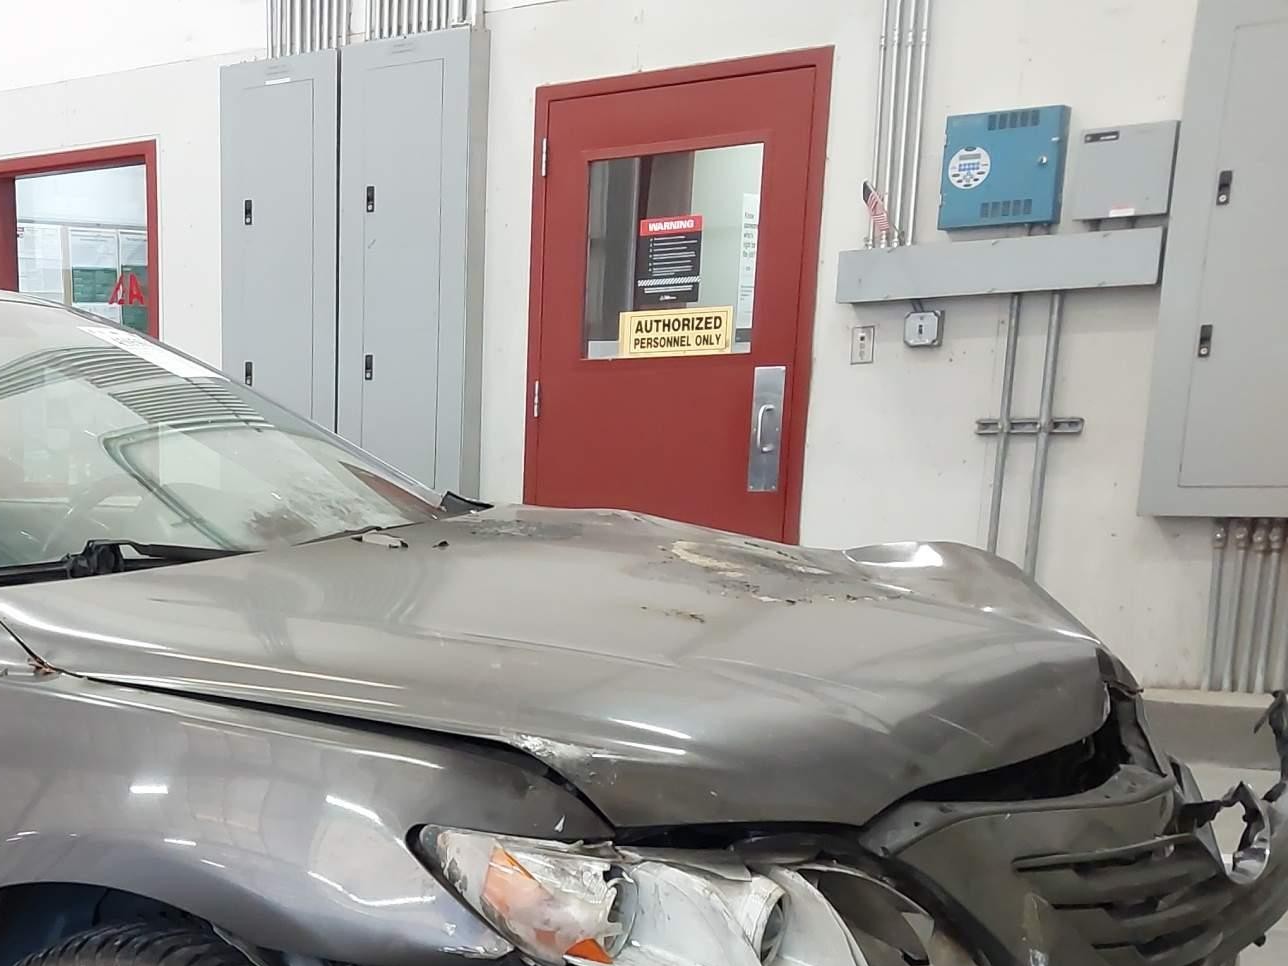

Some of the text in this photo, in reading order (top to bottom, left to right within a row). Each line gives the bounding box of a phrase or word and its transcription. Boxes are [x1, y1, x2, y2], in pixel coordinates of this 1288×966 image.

[648, 219, 695, 232] WARNING
[634, 315, 723, 335] AUTHORIZED
[633, 333, 722, 350] PERSONNEL ONLY
